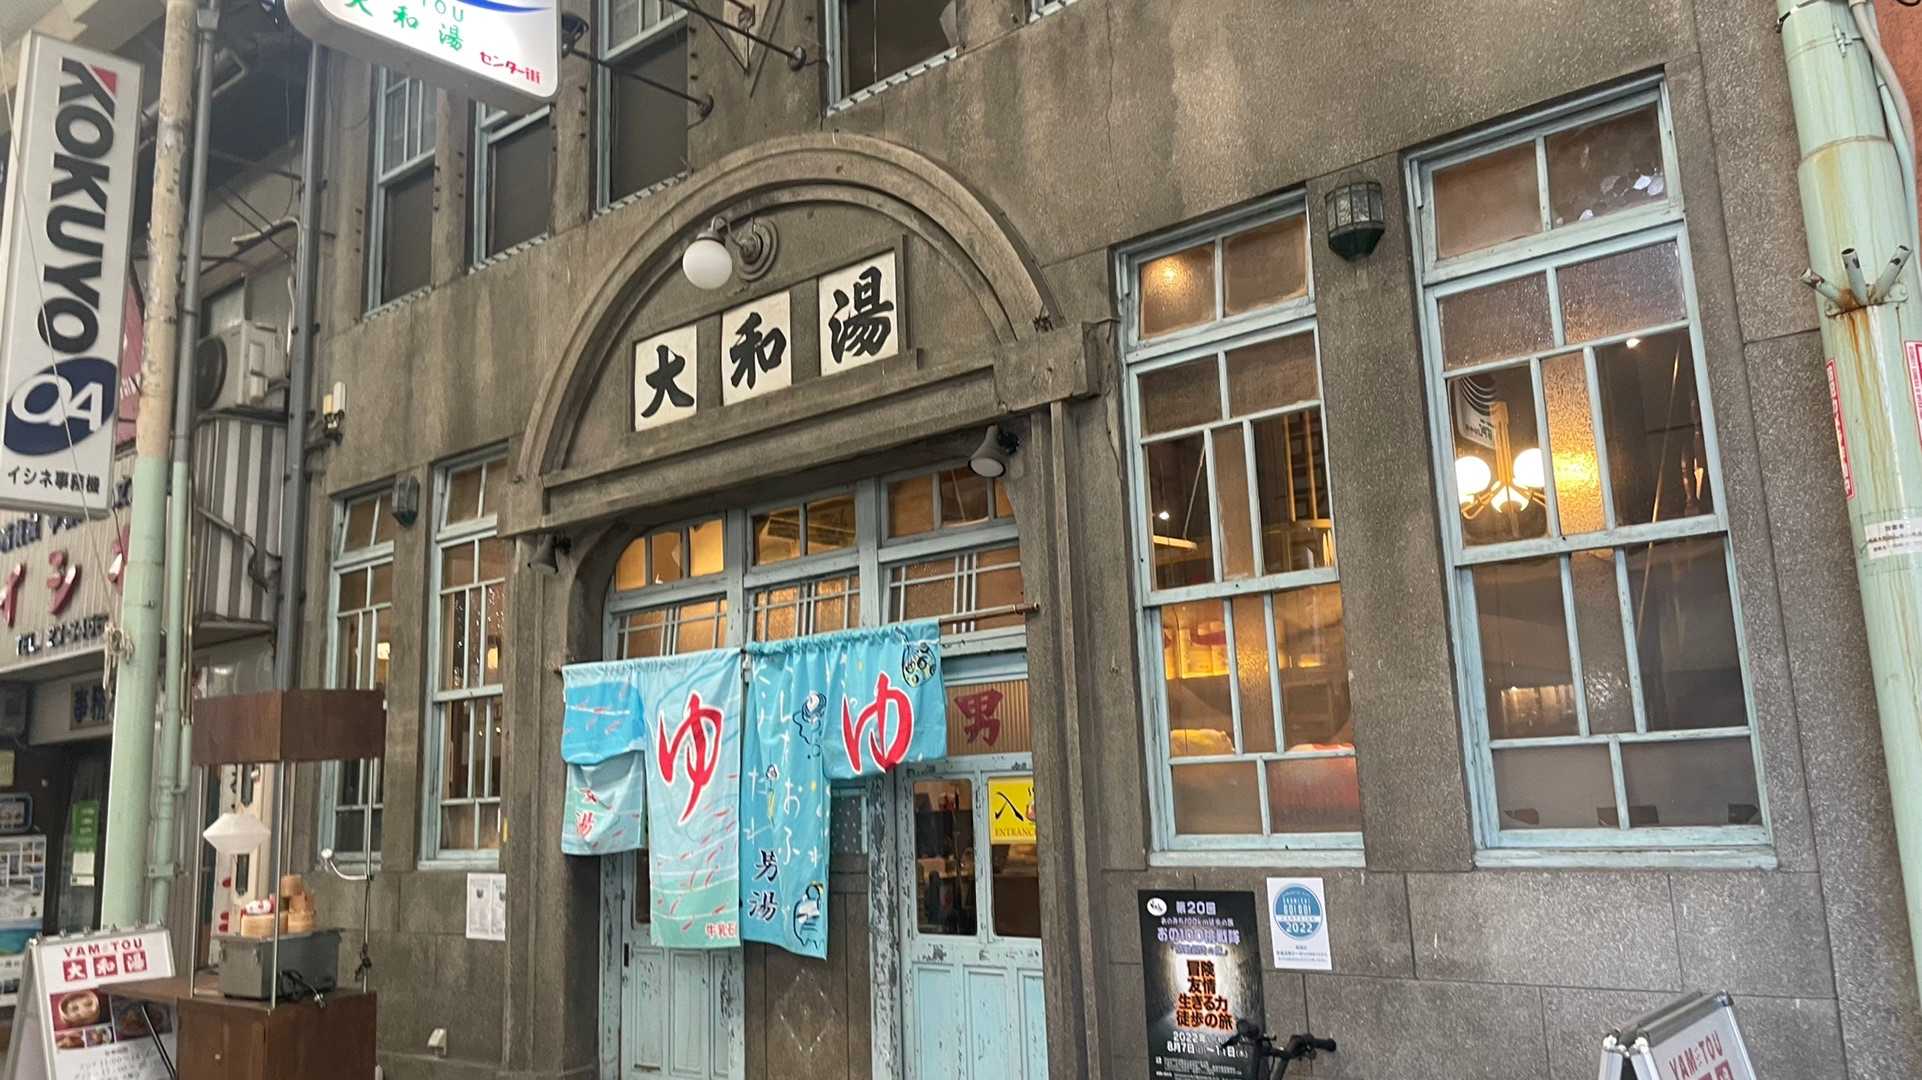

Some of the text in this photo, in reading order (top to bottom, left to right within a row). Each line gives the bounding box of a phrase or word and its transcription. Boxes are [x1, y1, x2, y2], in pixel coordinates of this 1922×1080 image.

[37, 57, 117, 354] KOKUYO
[640, 265, 894, 419] 大和湯
[841, 671, 915, 774] ゆ
[954, 689, 1004, 747] 男
[655, 690, 726, 824] ゆ
[748, 849, 779, 922] 男湯
[1286, 922, 1313, 934] 2022
[62, 949, 148, 982] 大和湯
[1186, 960, 1216, 978] 冒険
[1187, 977, 1217, 995] 友情
[1176, 1010, 1234, 1030] 徒歩の旅
[1178, 993, 1228, 1012] 生きる力
